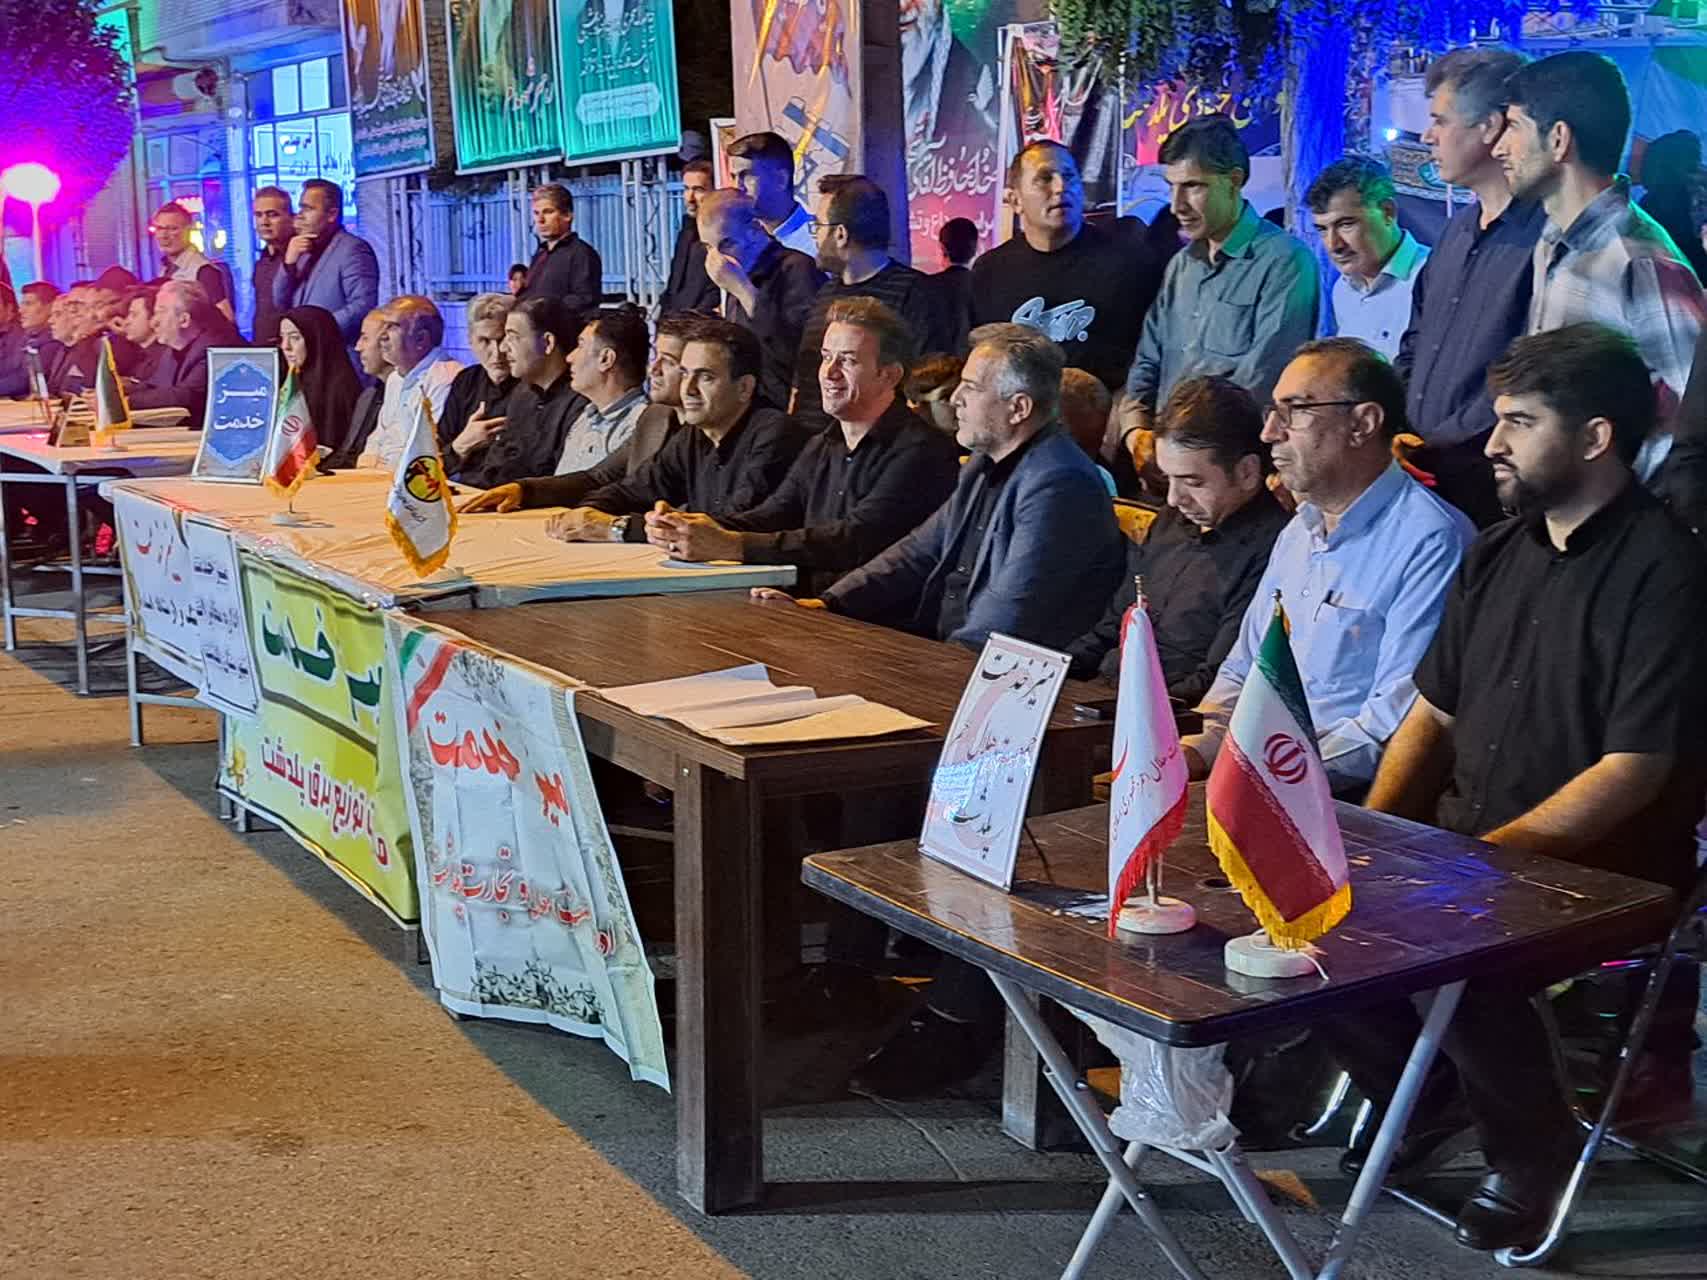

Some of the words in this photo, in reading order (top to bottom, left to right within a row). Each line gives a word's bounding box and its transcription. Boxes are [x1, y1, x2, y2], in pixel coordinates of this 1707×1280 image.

[217, 381, 268, 404] میز
[213, 414, 265, 432] خدمت
[261, 736, 305, 808] پلدشت
[427, 711, 521, 781] خدمت
[308, 762, 332, 816] برق
[333, 783, 364, 834] توزیع
